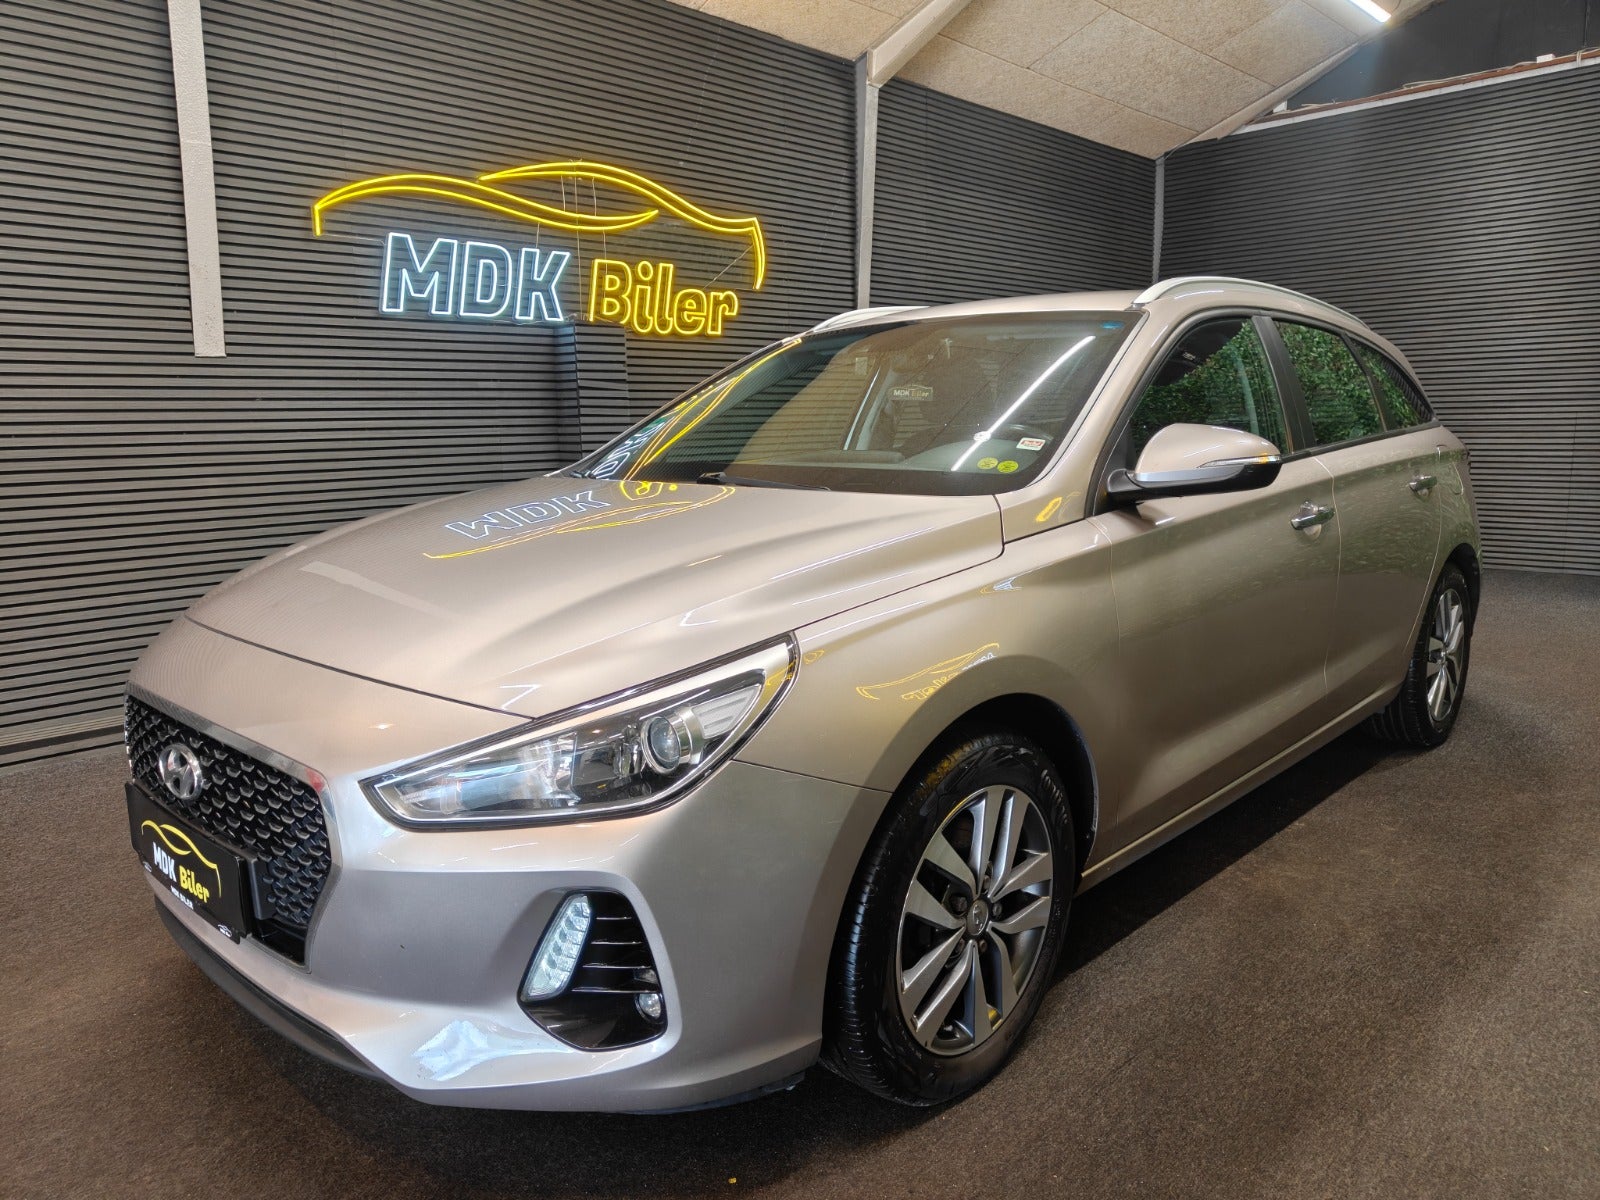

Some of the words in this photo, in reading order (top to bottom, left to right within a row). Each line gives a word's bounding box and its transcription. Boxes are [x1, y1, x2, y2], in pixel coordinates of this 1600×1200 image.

[380, 231, 571, 321] MDK
[588, 258, 739, 336] Biler
[152, 841, 177, 882] MDK
[179, 865, 210, 903] Biler
